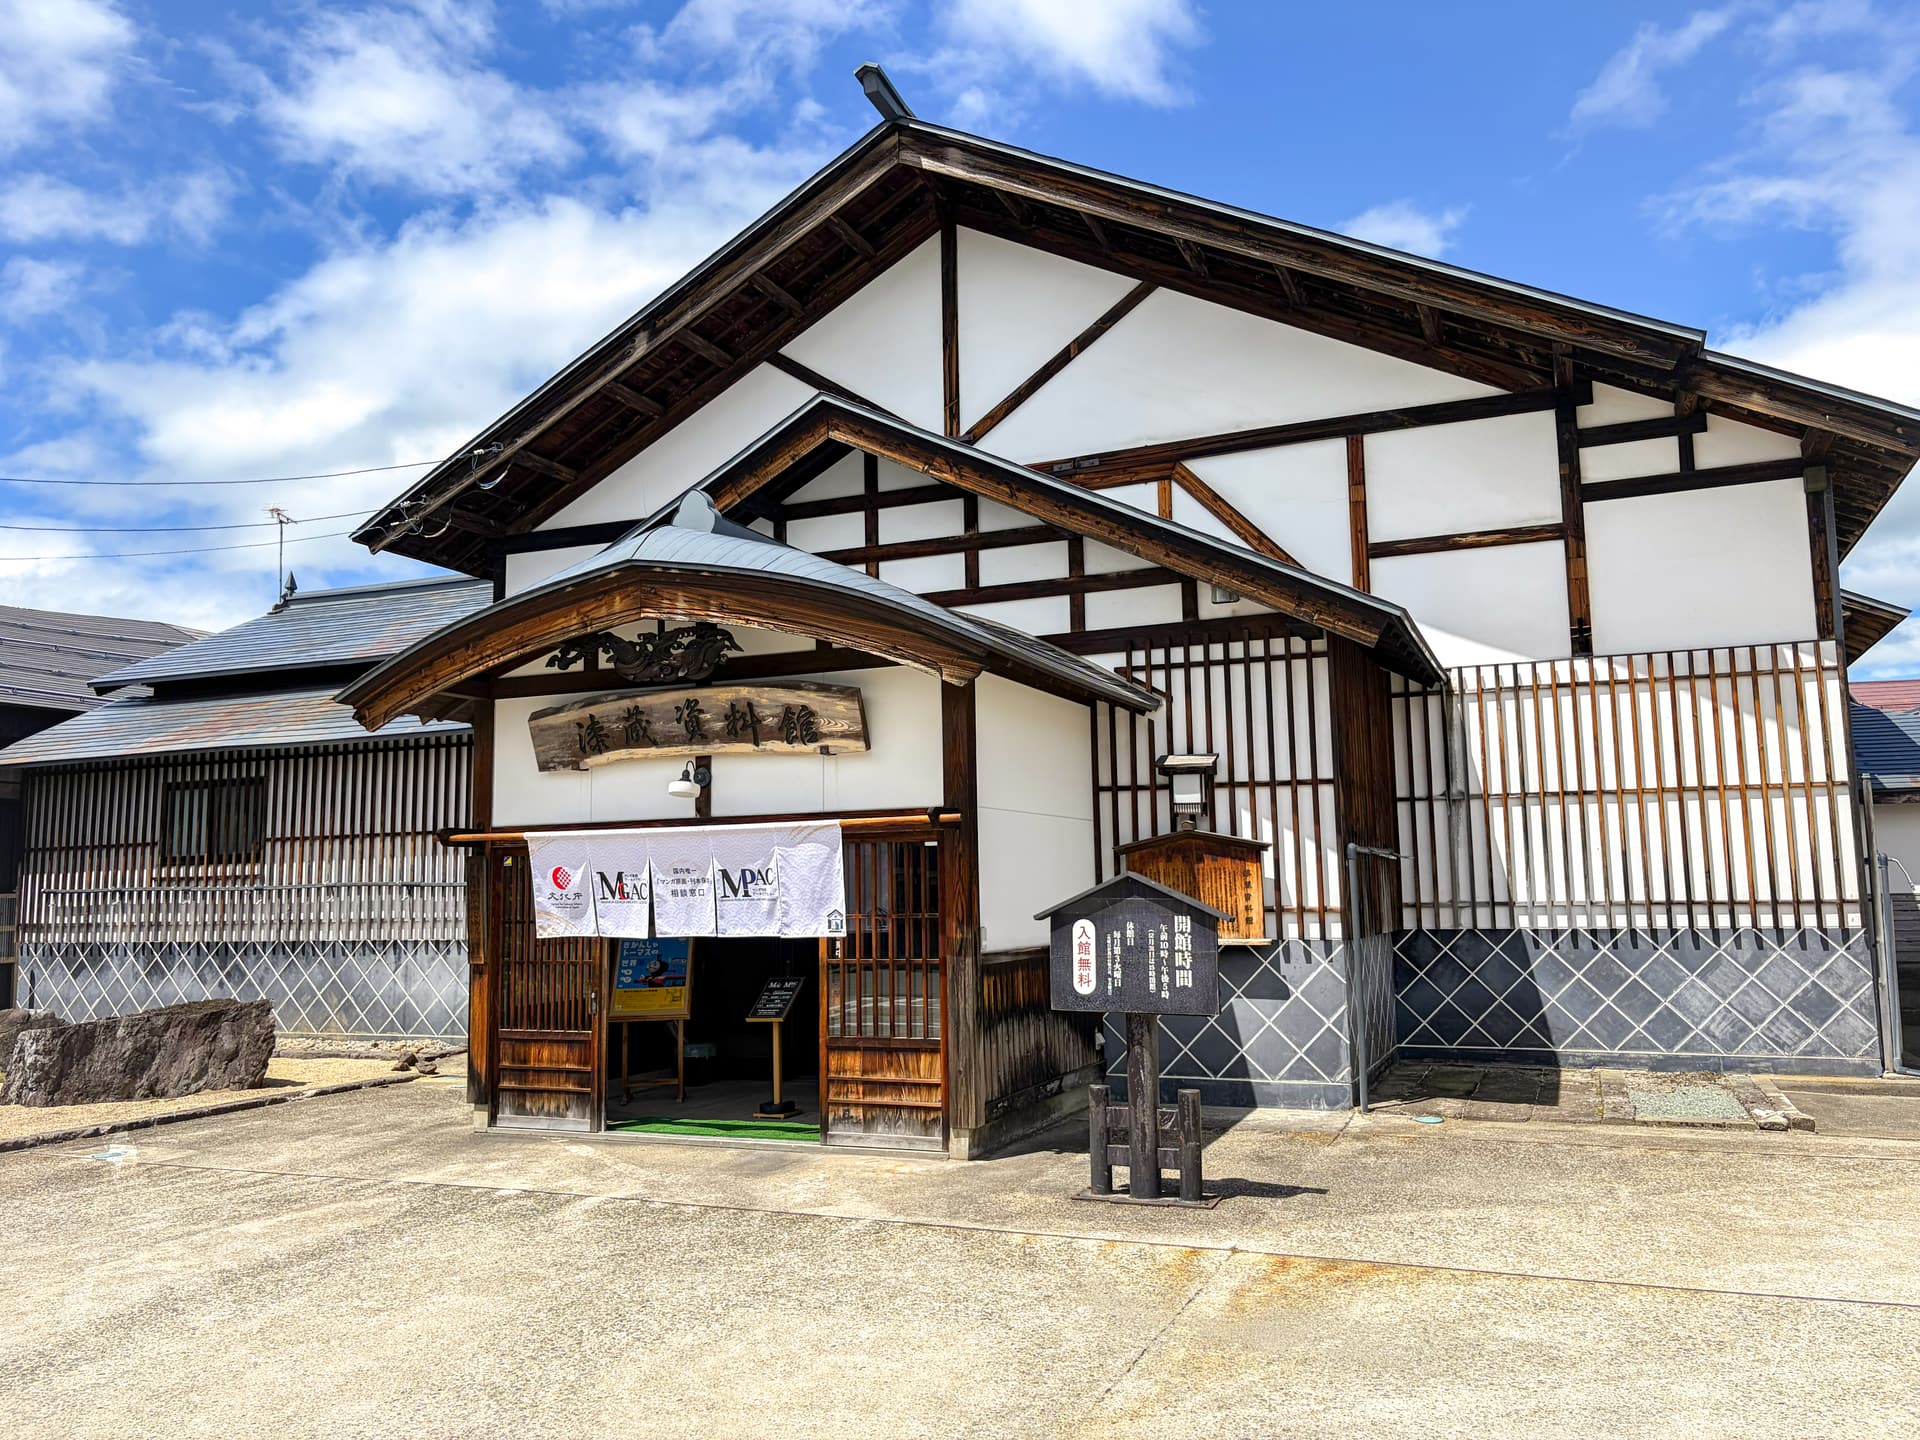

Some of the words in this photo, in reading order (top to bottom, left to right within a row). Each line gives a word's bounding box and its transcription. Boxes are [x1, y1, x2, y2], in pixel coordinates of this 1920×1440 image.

[575, 698, 819, 753] 漆蔵資料館
[598, 871, 648, 900] MGAC
[671, 888, 705, 898] 相談窓口
[718, 868, 775, 898] MPAC
[1126, 921, 1135, 946] 休館日
[623, 948, 659, 956] トーマスの
[1077, 925, 1092, 988] 入館無料
[1173, 915, 1193, 988] 開館時間
